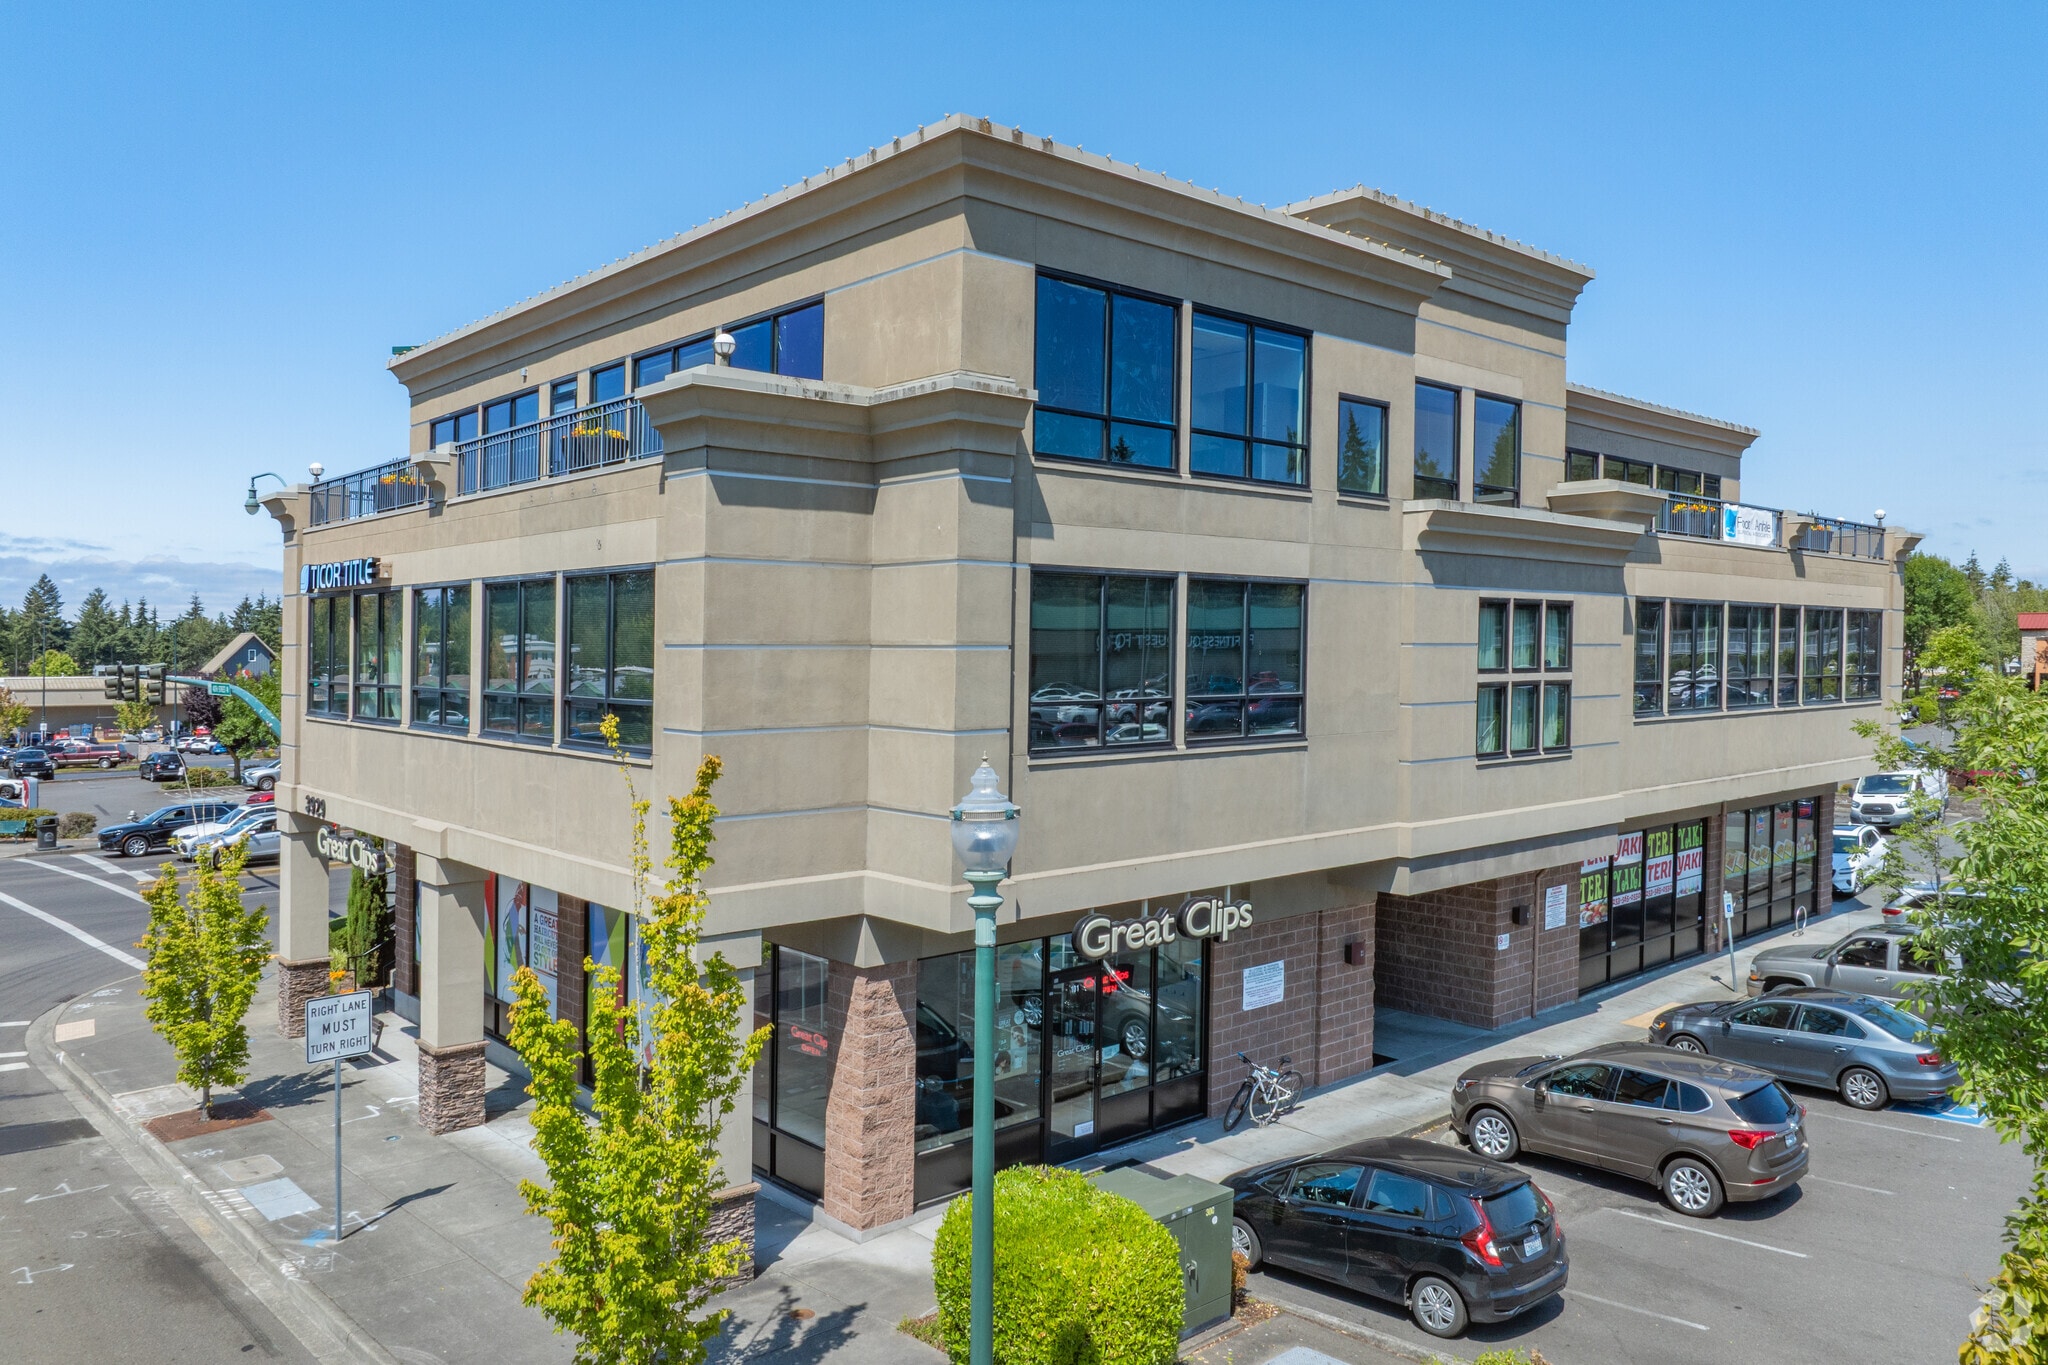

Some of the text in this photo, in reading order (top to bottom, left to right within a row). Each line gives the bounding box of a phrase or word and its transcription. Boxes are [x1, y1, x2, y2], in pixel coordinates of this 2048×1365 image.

[311, 557, 373, 589] TICOR TITLE
[317, 827, 379, 878] Great Clips
[534, 912, 539, 924] A
[1078, 899, 1254, 957] Great Clips
[311, 1000, 367, 1018] RIGHT LANE
[322, 1018, 356, 1035] MUST
[311, 1036, 367, 1055] TURN RIGHT
[801, 1043, 821, 1057] OPEN
